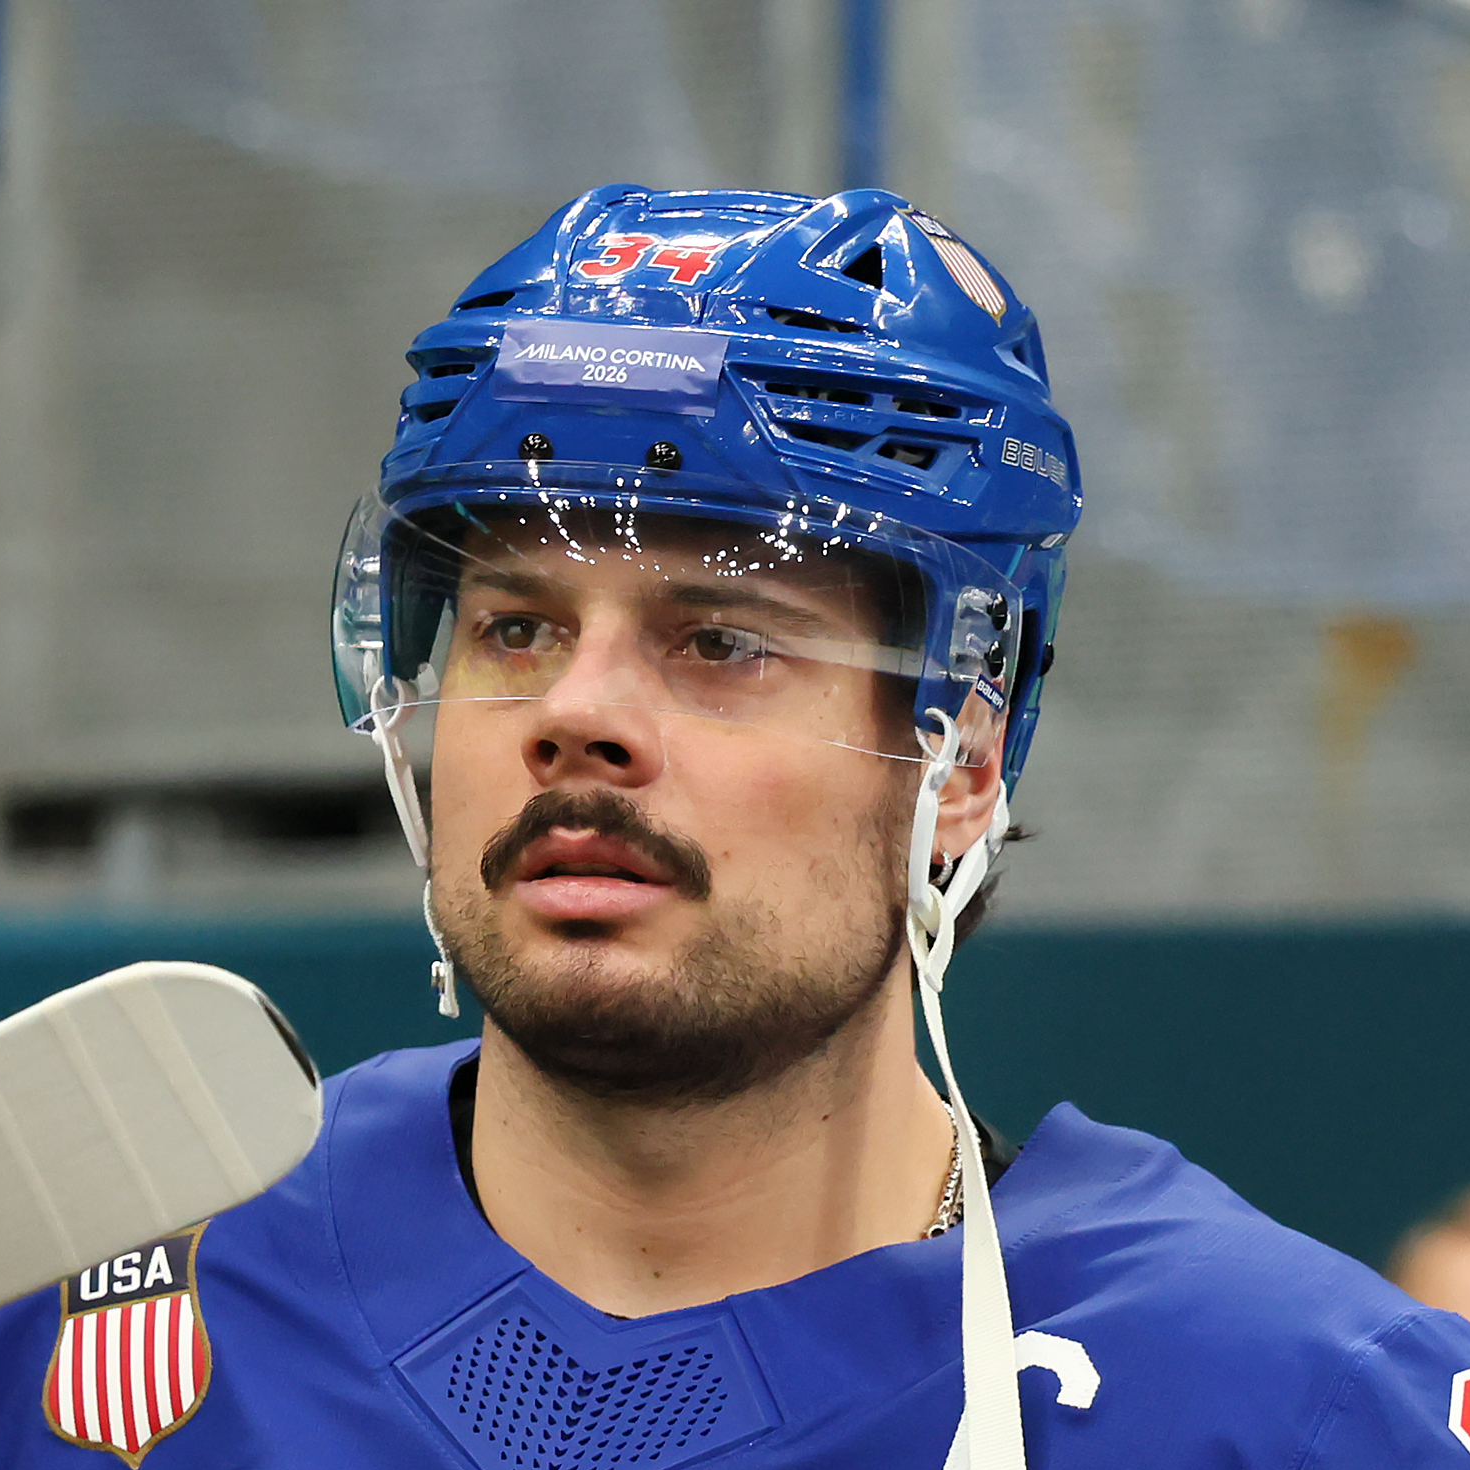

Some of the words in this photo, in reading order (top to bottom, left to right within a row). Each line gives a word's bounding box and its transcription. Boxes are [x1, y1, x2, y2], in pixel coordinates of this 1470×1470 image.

[577, 234, 727, 287] 34
[514, 343, 607, 363] MILANO
[610, 348, 706, 373] CORTINA
[582, 364, 628, 384] 2026
[80, 1245, 174, 1301] USA
